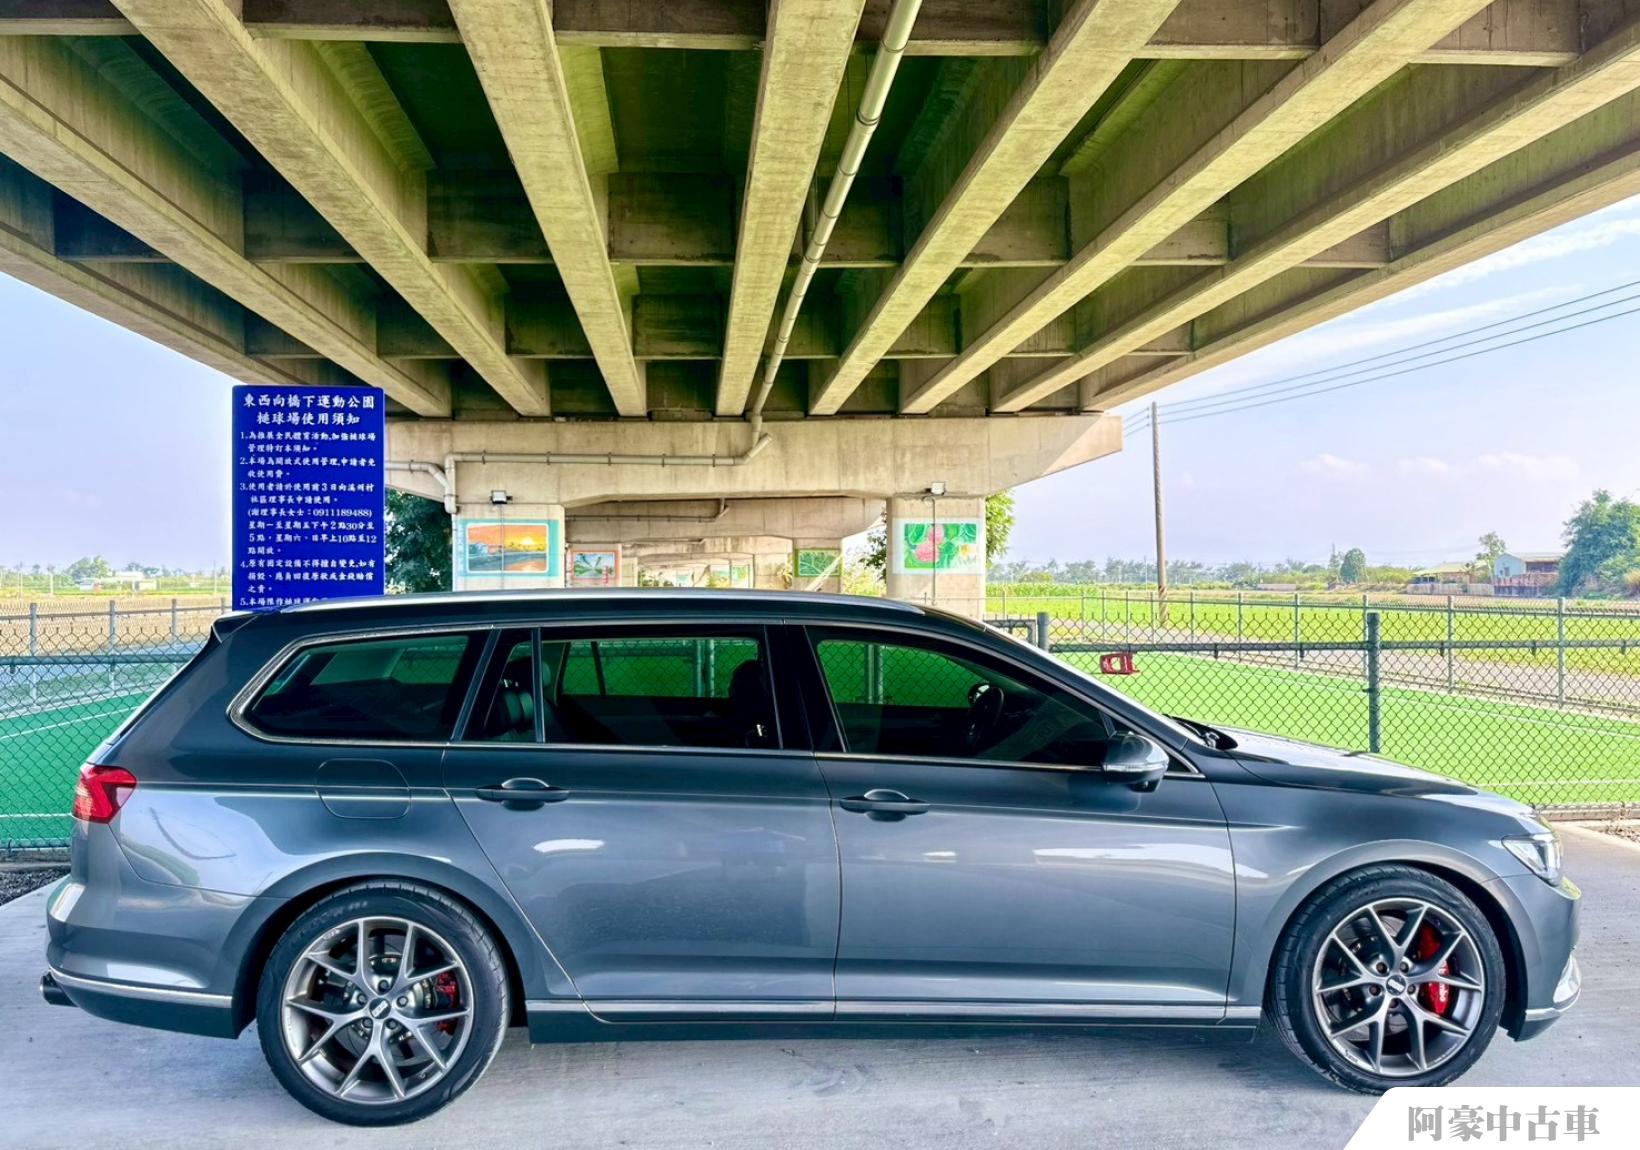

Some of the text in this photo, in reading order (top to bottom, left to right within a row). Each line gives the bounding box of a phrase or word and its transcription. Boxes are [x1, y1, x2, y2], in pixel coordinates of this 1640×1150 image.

[243, 393, 375, 409] 東西向橋下運動公園
[256, 411, 361, 426] 槌球場使用須知
